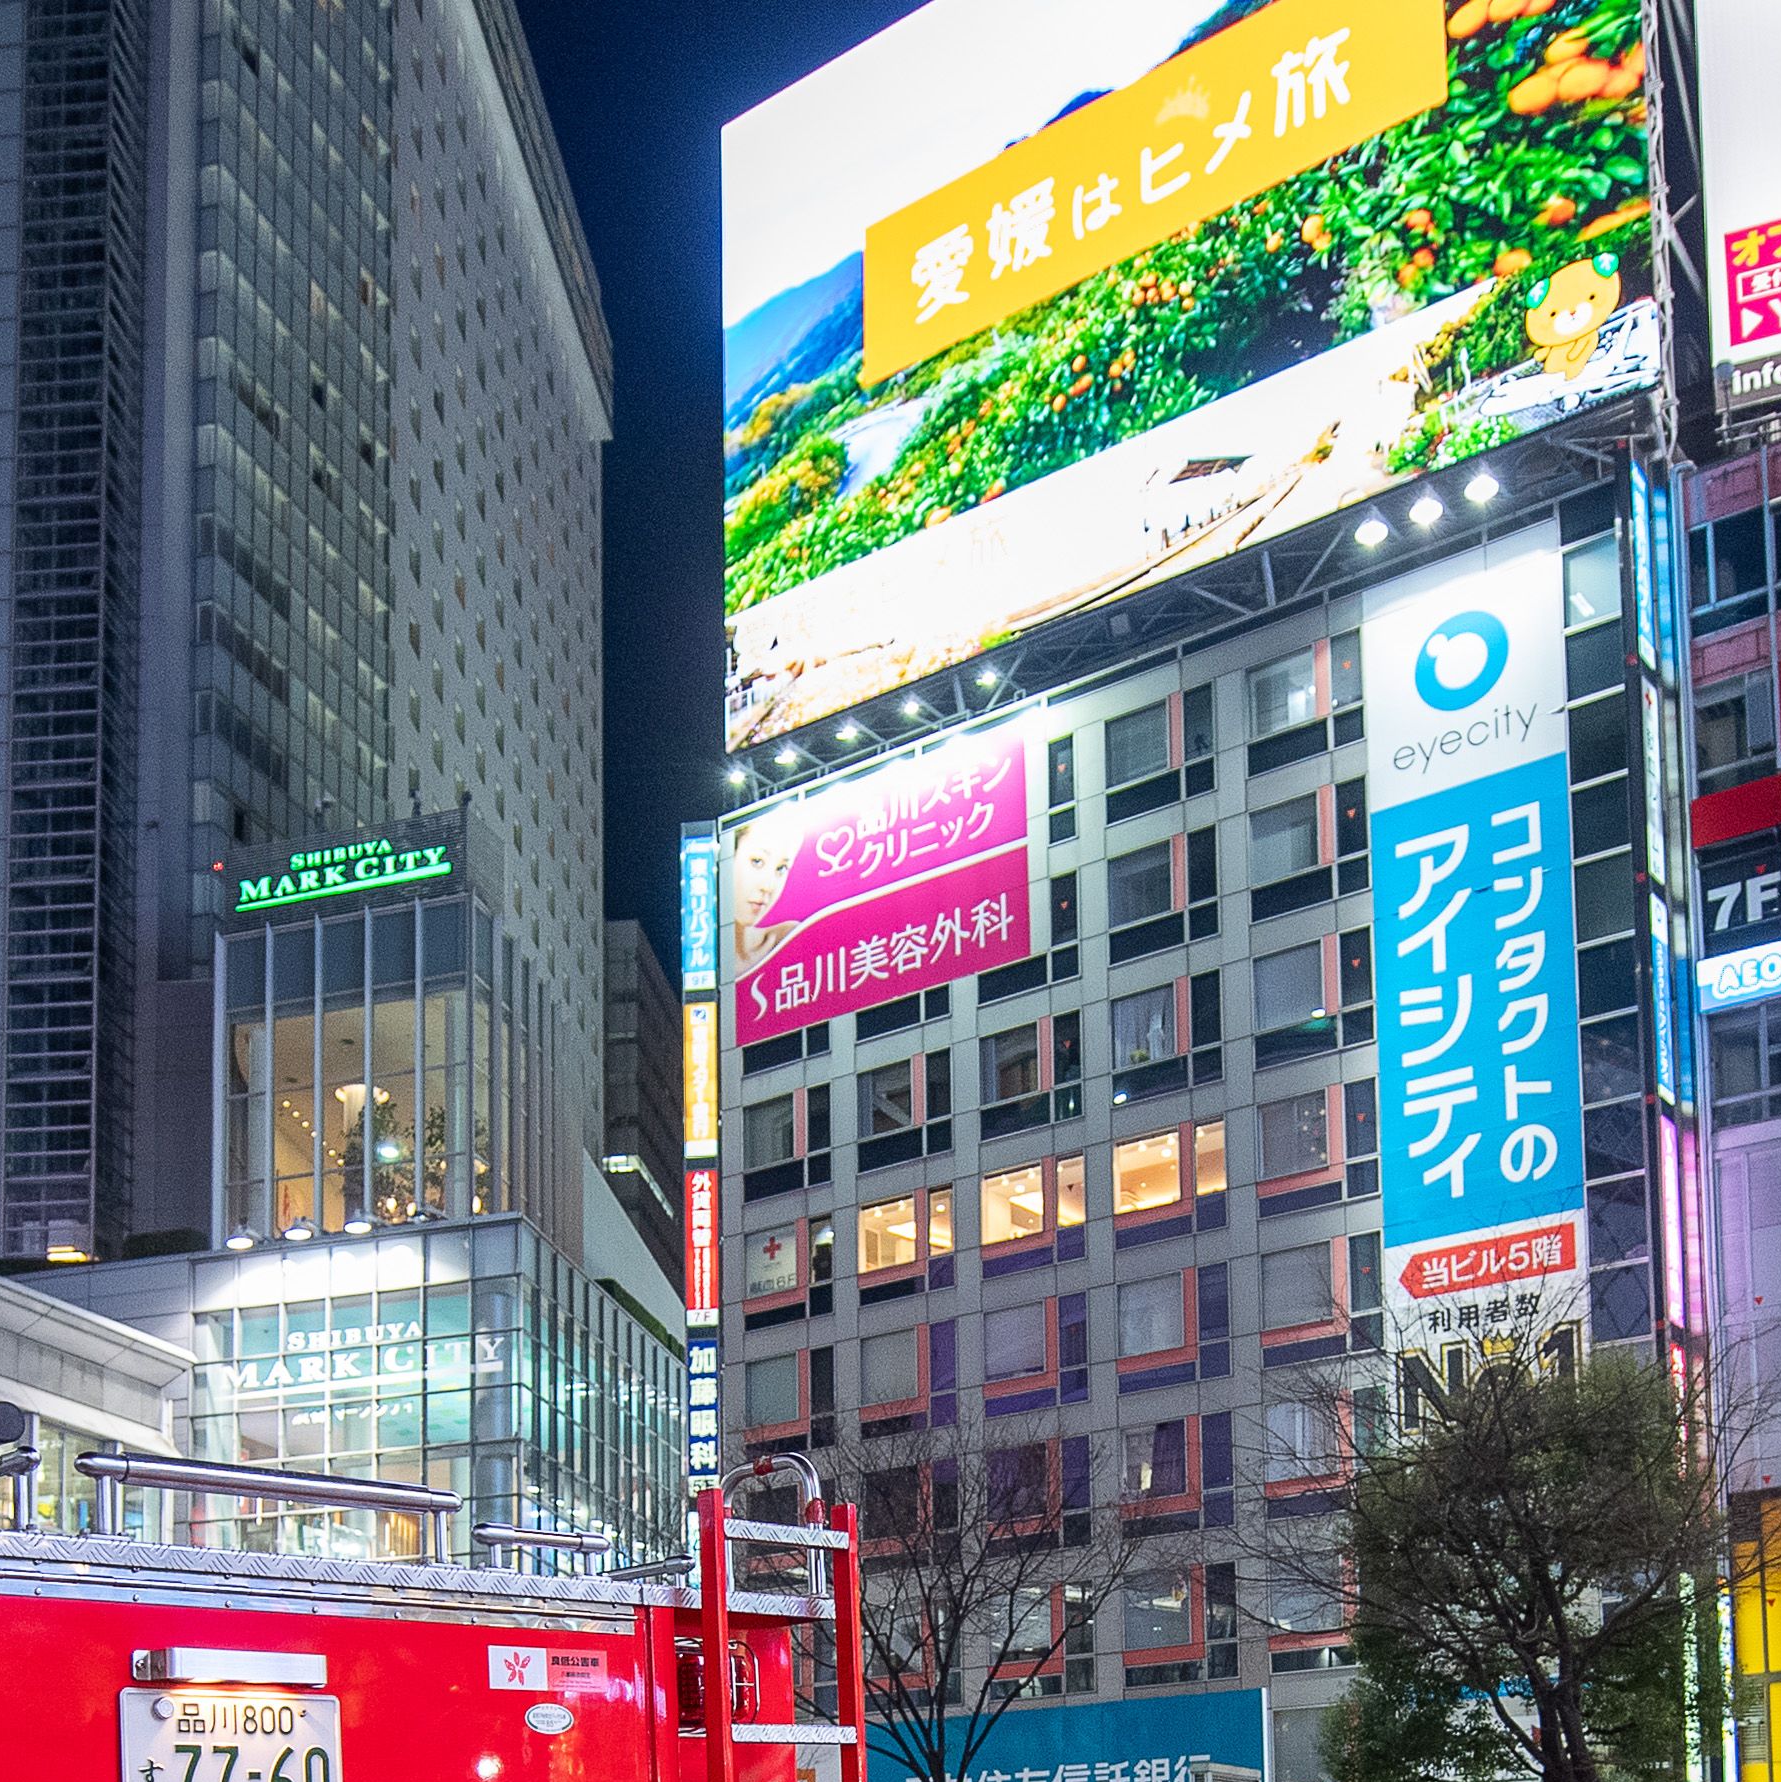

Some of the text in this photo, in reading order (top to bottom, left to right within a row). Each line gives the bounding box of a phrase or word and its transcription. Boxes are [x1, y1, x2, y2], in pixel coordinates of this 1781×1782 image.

[912, 27, 1351, 325] 愛媛はヒメ旅
[1394, 703, 1537, 774] eyecity
[290, 839, 392, 871] SHIBUYA
[859, 801, 994, 879] クリニック
[239, 846, 447, 902] MARK CITY
[1707, 870, 1781, 931] 7F
[692, 975, 709, 987] 9F
[775, 892, 1014, 1013] 品川美容外科
[1395, 823, 1482, 1199] アイシティ
[1491, 801, 1558, 1183] コンタクトの
[1422, 1235, 1562, 1289] 当ビル5階
[287, 1321, 423, 1352] SHIBUYA
[693, 1311, 711, 1322] 7F
[1429, 1292, 1540, 1334] 利用者数
[222, 1337, 505, 1390] MARK CITY
[689, 1346, 718, 1470] 加藤眼科
